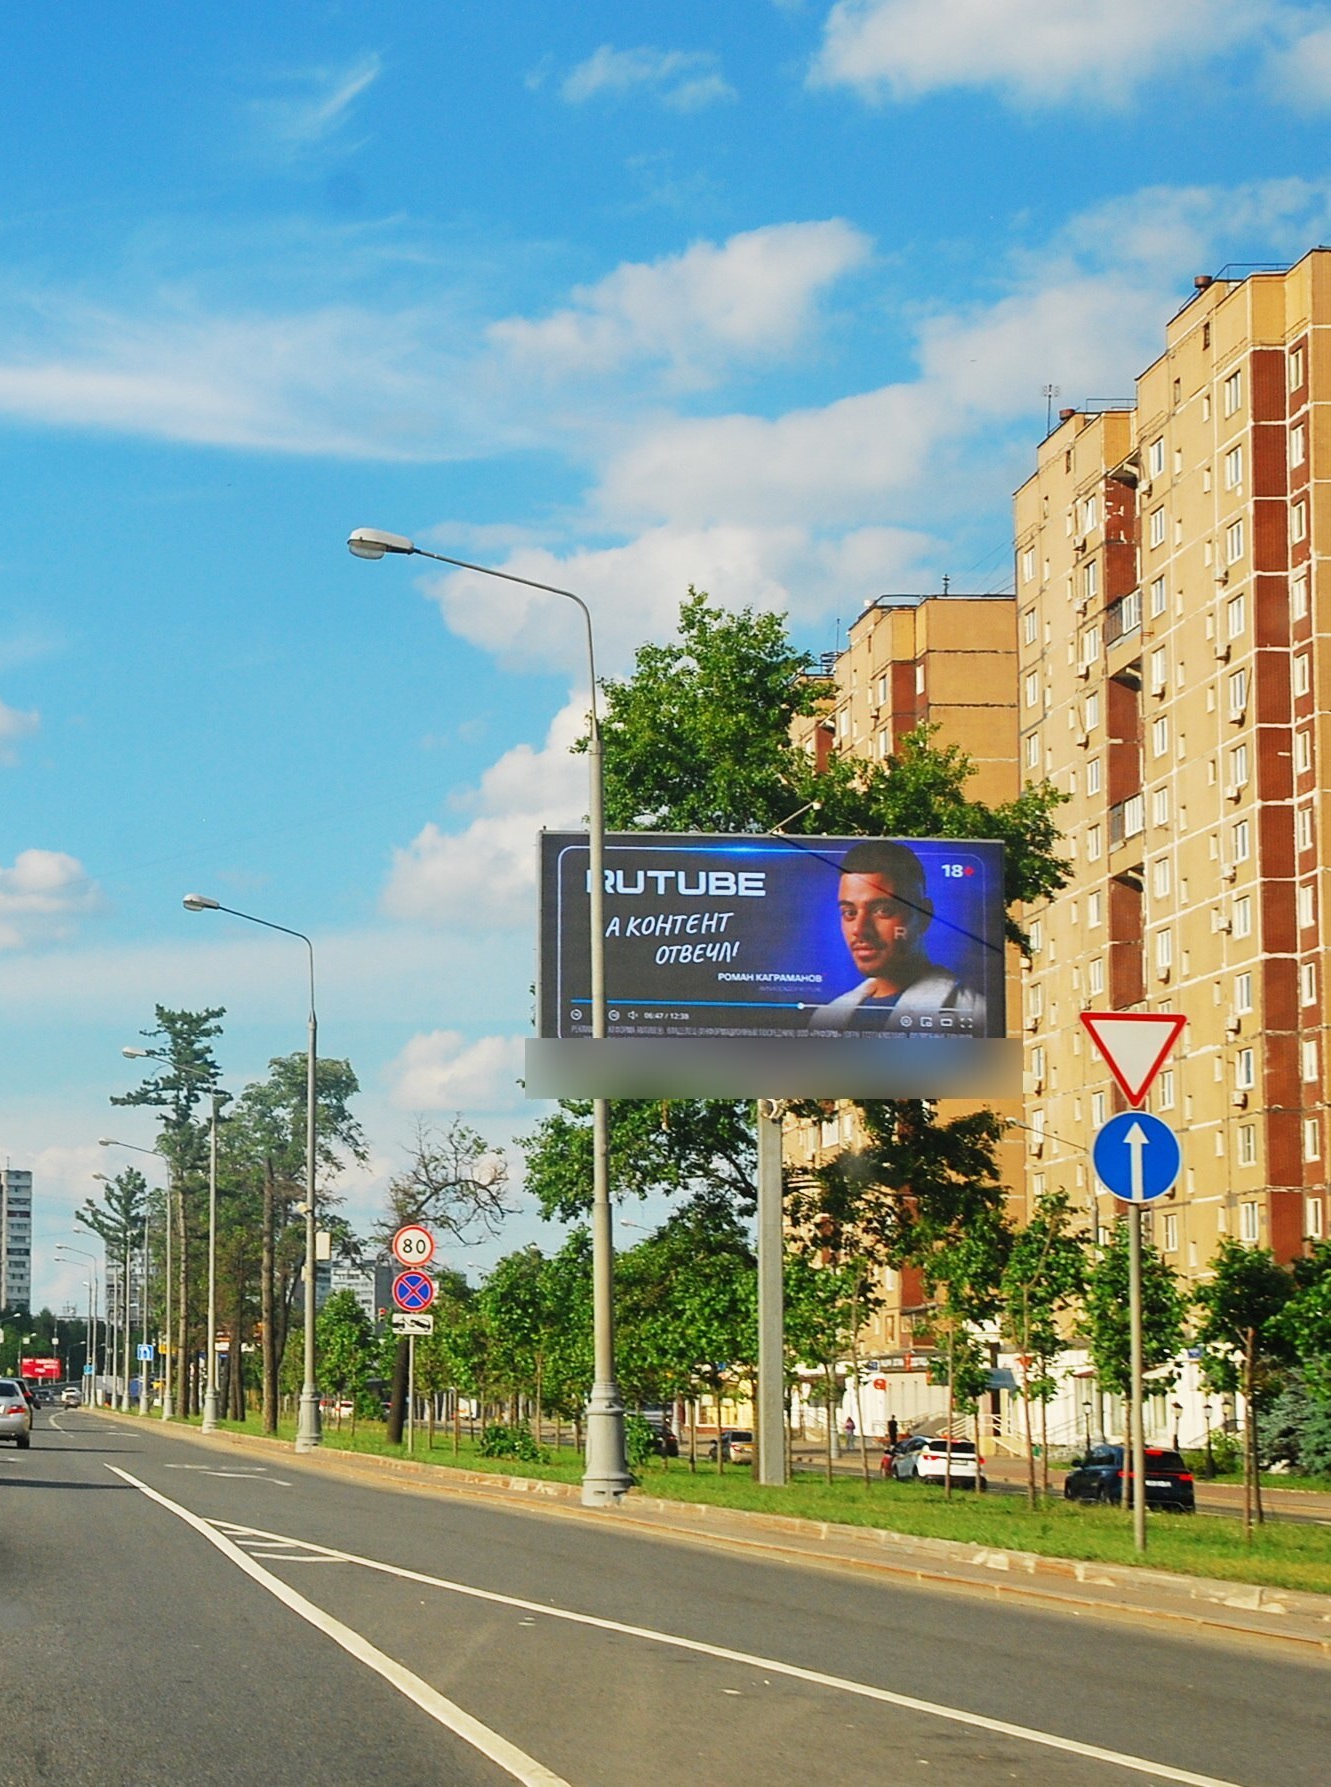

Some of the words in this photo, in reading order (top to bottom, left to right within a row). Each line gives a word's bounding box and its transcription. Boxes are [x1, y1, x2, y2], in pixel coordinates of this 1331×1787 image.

[586, 869, 766, 897] RUTUBE
[605, 916, 620, 938] А
[625, 912, 735, 938] КОНТЕНТ
[717, 972, 754, 982] РОМАН
[755, 973, 823, 983] КАГРАМАНОВ
[402, 1238, 426, 1255] 80
